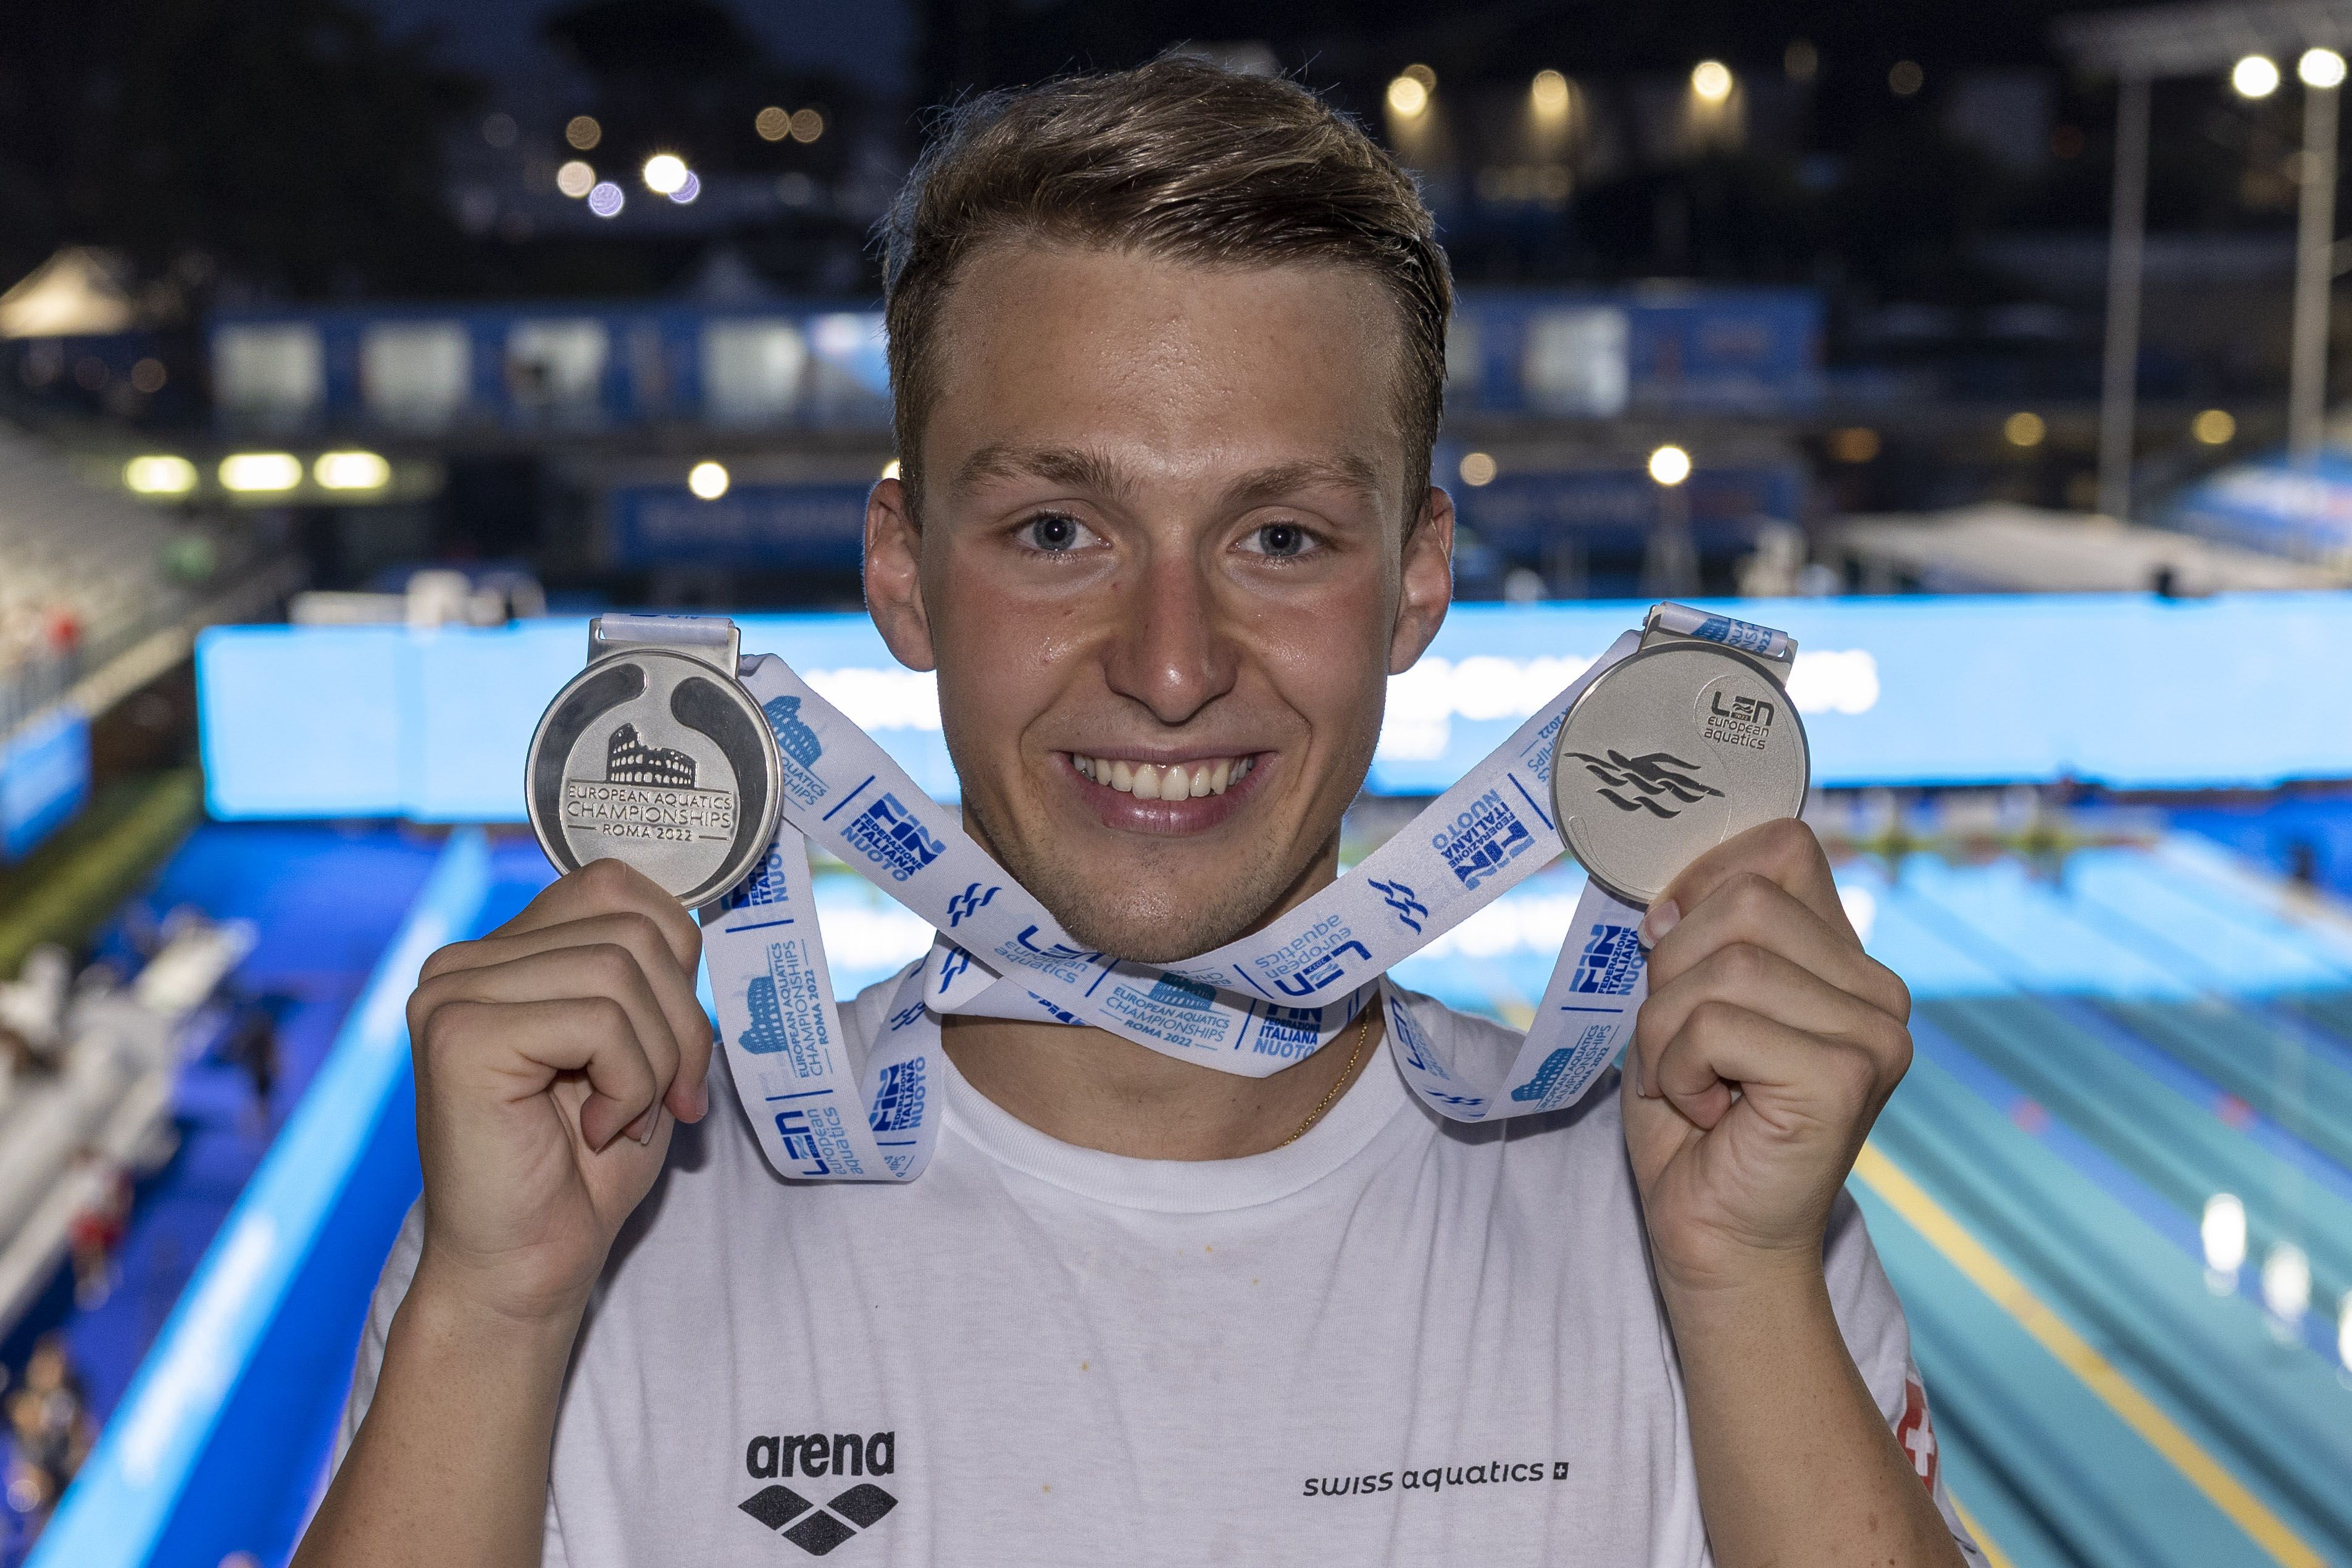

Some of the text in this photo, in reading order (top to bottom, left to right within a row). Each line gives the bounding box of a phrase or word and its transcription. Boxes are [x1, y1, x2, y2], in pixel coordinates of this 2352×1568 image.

[1704, 728, 1766, 749] aquatics
[1708, 716, 1769, 737] european
[567, 801, 732, 828] CHAMPIONSHIPS
[569, 785, 733, 810] EUROPEAN AQUATICS
[1432, 789, 1501, 849] NUOTO
[603, 824, 693, 842] ROMA 2022
[840, 826, 908, 882] NUOTO
[851, 818, 915, 876] ITALIANA
[860, 812, 925, 870] FEDERAZIONE
[1440, 802, 1510, 859] ITALIANA
[1449, 812, 1516, 869] FEDERAZIONE
[994, 947, 1078, 983] aquatics
[1255, 915, 1341, 969] aquatics
[1265, 927, 1351, 978] european
[1597, 927, 1630, 994] FEDERAZIONE
[1605, 930, 1638, 995] ITALIANA
[772, 942, 810, 1078] EUROPEAN AQUATICS
[783, 940, 823, 1076] CHAMPIONSHIPS
[805, 969, 828, 1045] ROMA 2022
[1106, 996, 1225, 1042] CHAMPIONSHIPS
[1113, 986, 1230, 1029] EUROPEAN AQUATICS
[1124, 1019, 1192, 1046] ROMA 2022
[1264, 1016, 1322, 1032] FEDERAZIONE
[1259, 1025, 1319, 1045] ITALIANA
[1568, 1025, 1599, 1072] AQUATICS
[890, 1062, 906, 1131] FEDERAZIONE
[898, 1060, 915, 1130] ITALIANA
[909, 1056, 926, 1128] NUOTO
[1569, 1047, 1609, 1095] ROMA 2022
[807, 1109, 846, 1174] european
[824, 1107, 864, 1174] aquatics
[746, 1431, 895, 1479] arena
[1303, 1461, 1544, 1497] swiss aquatics
